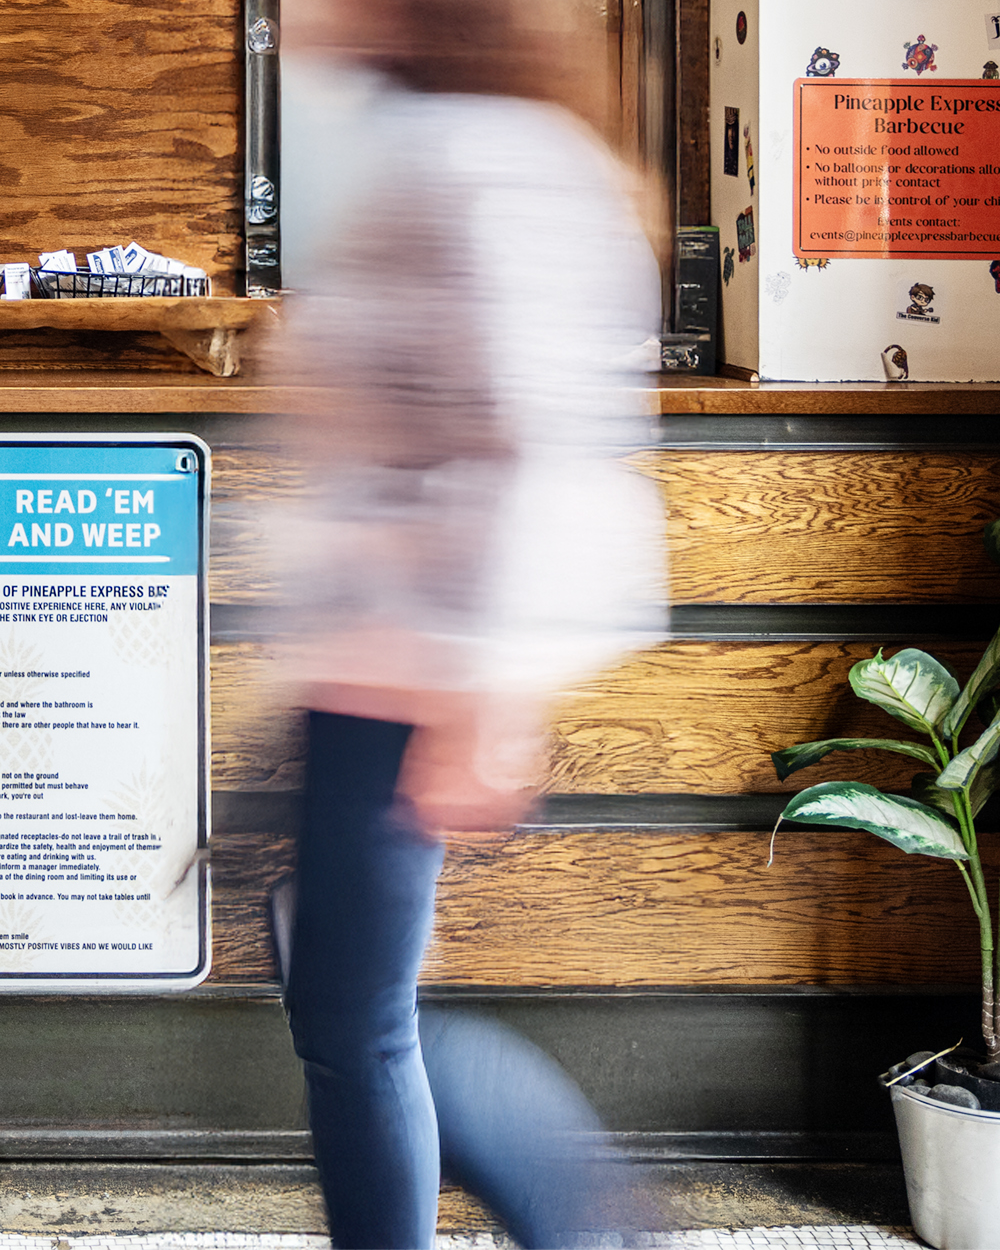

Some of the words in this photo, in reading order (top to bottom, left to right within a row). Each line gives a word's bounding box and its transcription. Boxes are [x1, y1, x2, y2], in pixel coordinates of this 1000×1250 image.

[834, 94, 924, 114] Pineapple
[931, 95, 1000, 114] Express
[875, 118, 965, 134] Barbecue
[815, 145, 830, 154] No
[834, 145, 877, 155] outside
[881, 145, 910, 155] food
[914, 146, 959, 156] allowed
[16, 489, 97, 514] READ
[8, 523, 75, 547] AND
[82, 523, 161, 547] WEEP
[3, 585, 18, 597] OF
[22, 586, 86, 597] PINEAPPLE
[91, 586, 144, 597] EXPRESS
[12, 614, 36, 622] STINK
[39, 614, 54, 622] EYE
[56, 614, 67, 622] OR
[70, 614, 108, 622] EJECTION
